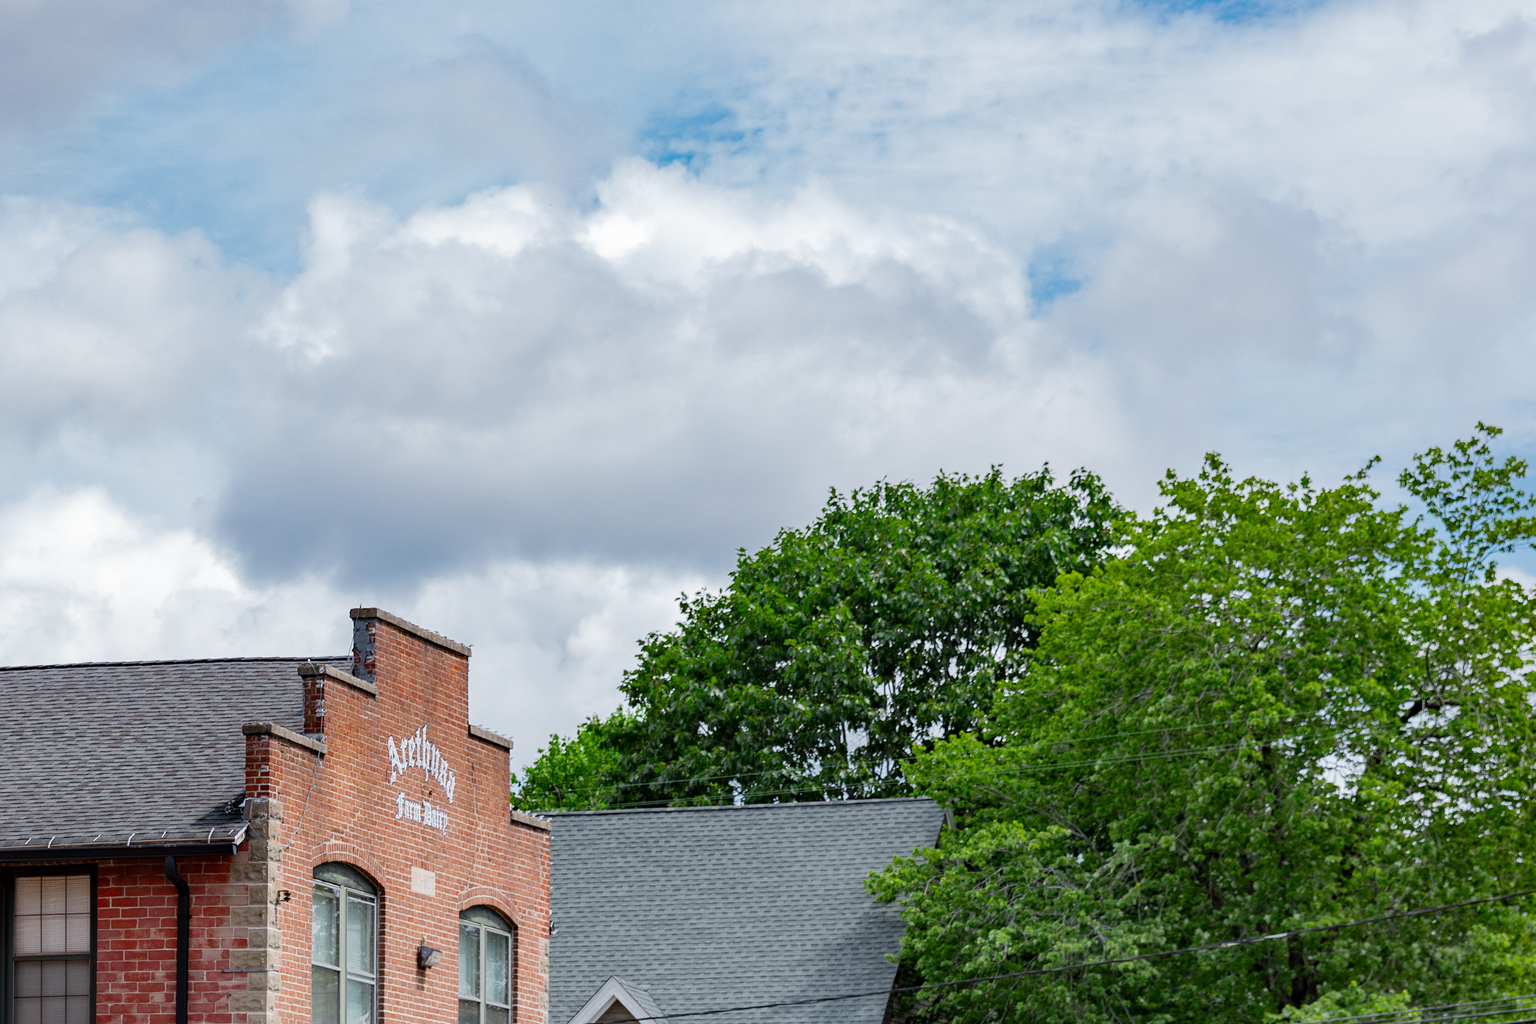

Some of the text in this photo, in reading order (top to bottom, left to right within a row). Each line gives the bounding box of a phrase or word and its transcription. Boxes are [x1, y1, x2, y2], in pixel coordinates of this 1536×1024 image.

[387, 723, 456, 805] Arethusa
[395, 791, 449, 837] Farm Dairy
